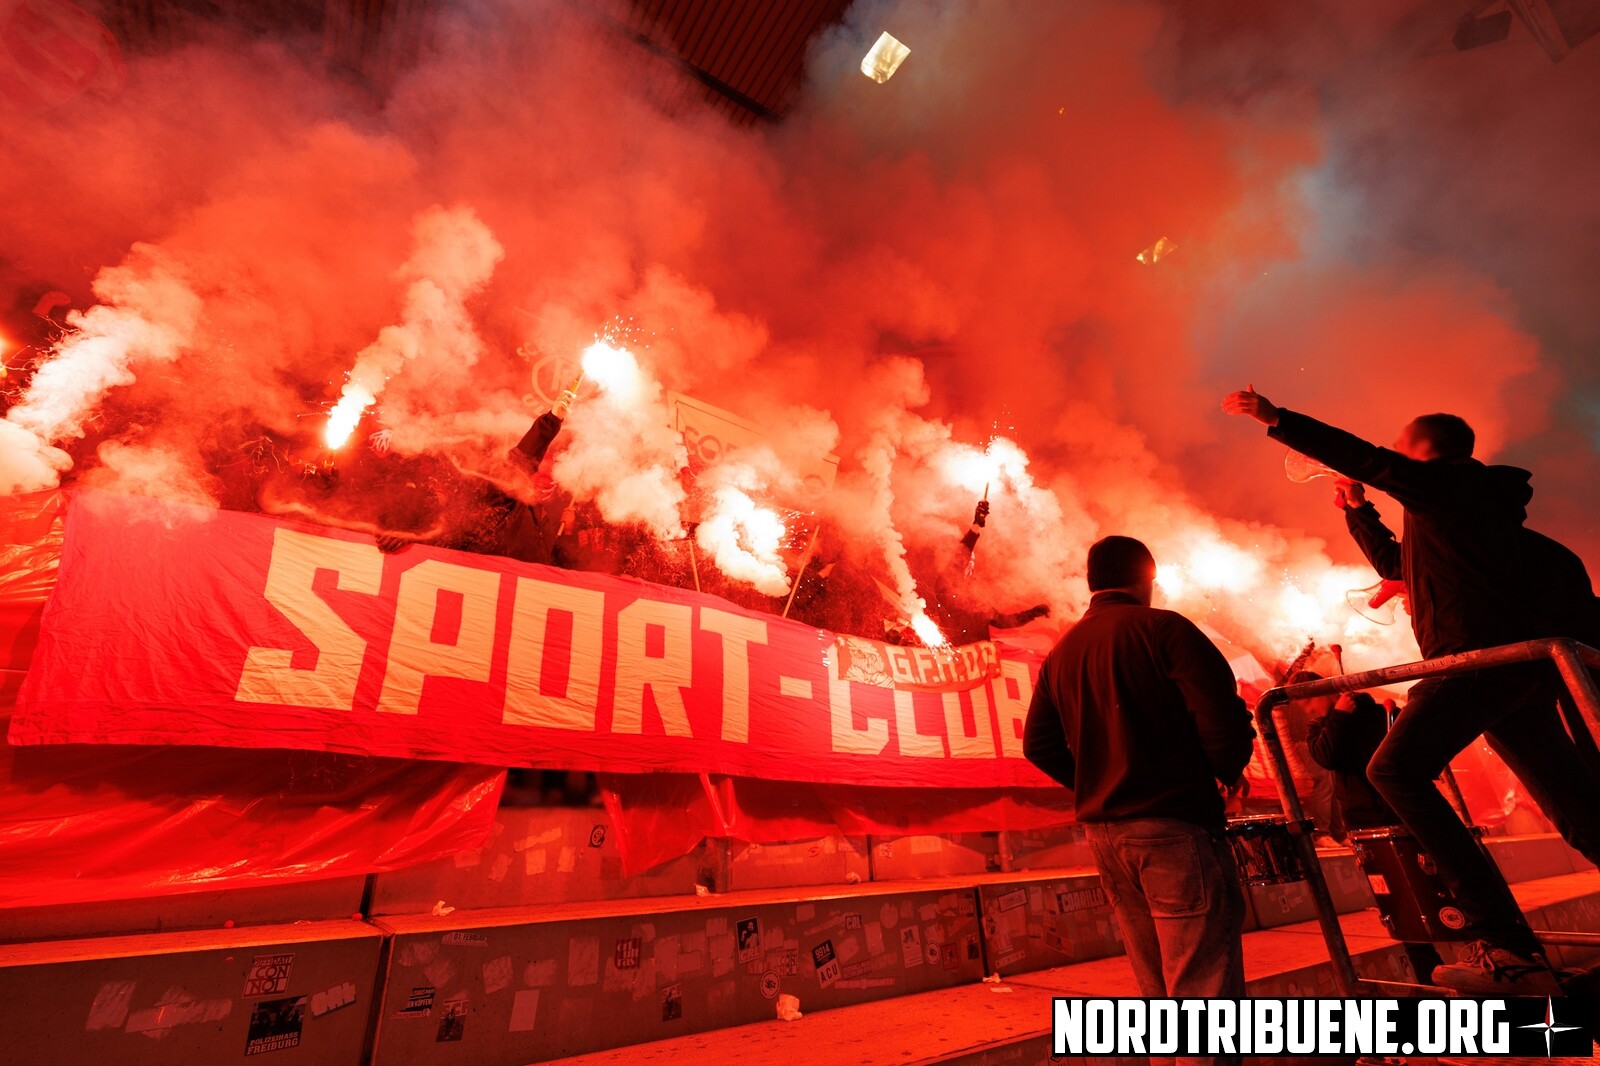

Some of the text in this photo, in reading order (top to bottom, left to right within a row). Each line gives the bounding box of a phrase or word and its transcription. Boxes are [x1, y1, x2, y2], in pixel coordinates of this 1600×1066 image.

[235, 526, 1034, 759] SPORT-CLUB
[740, 948, 760, 961] CRL
[814, 942, 831, 959] 9914
[820, 963, 839, 984] ACU
[247, 1038, 299, 1055] FREIBURG
